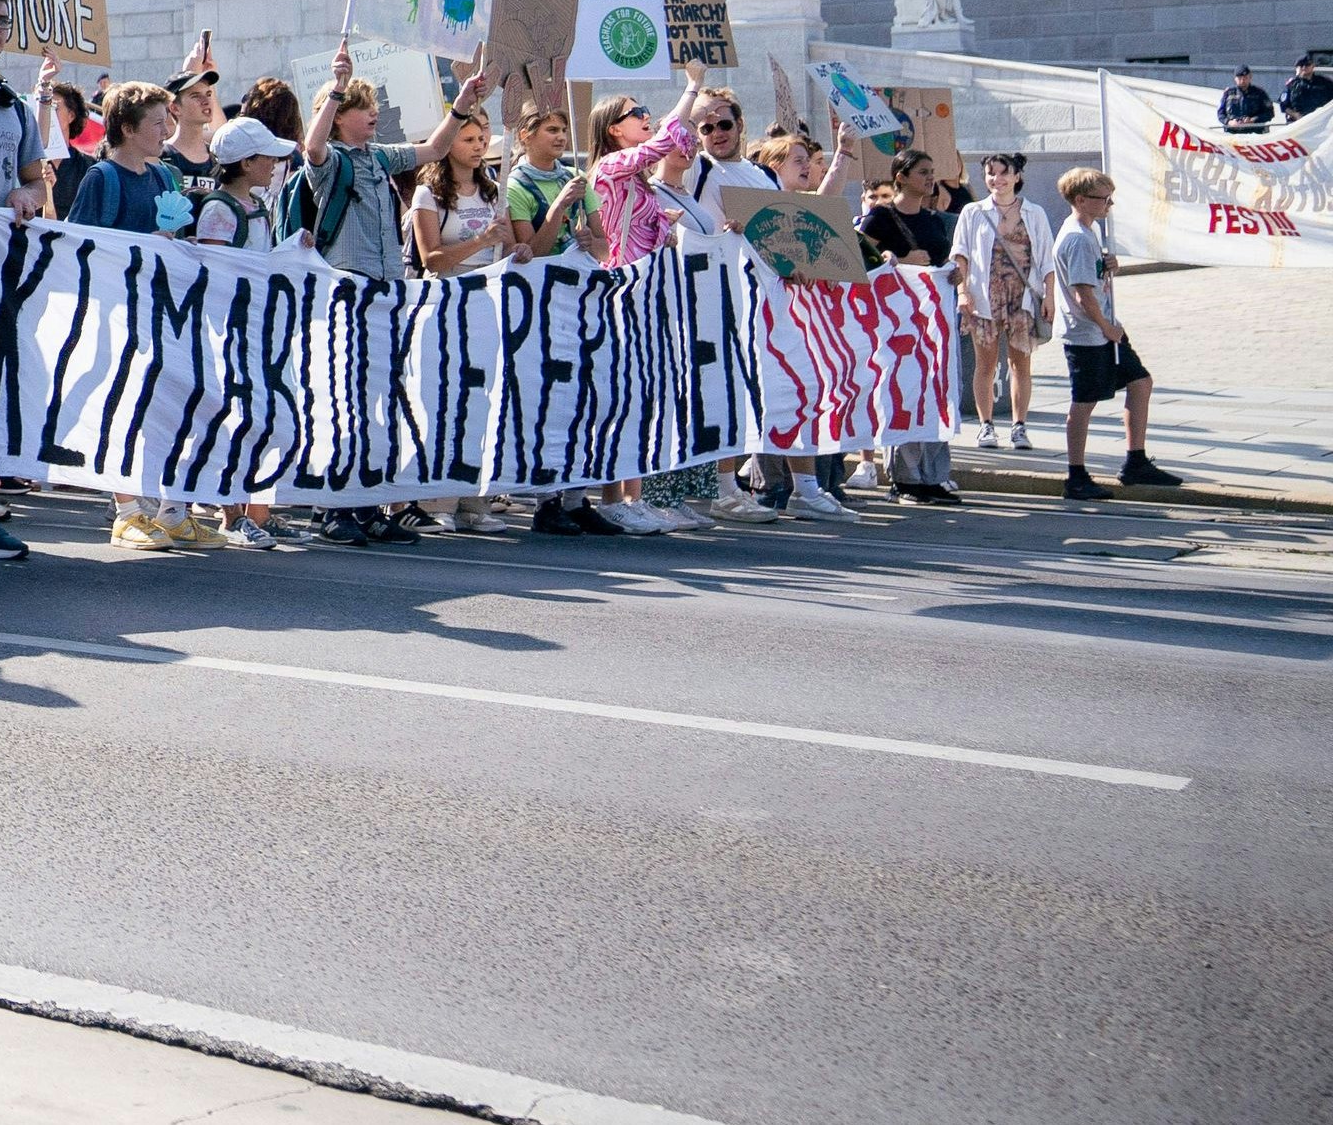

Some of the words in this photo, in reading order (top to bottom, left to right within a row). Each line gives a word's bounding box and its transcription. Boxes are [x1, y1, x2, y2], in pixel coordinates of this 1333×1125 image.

[663, 3, 727, 23] TRIARCHY
[600, 16, 617, 56] TEACHERS
[616, 9, 631, 19] FOR
[633, 11, 656, 38] FUTURE
[666, 25, 690, 39] OT
[694, 24, 723, 39] THE
[669, 41, 728, 65] LANET
[1232, 137, 1310, 163] EUCH
[1208, 204, 1302, 237] FEST!!!
